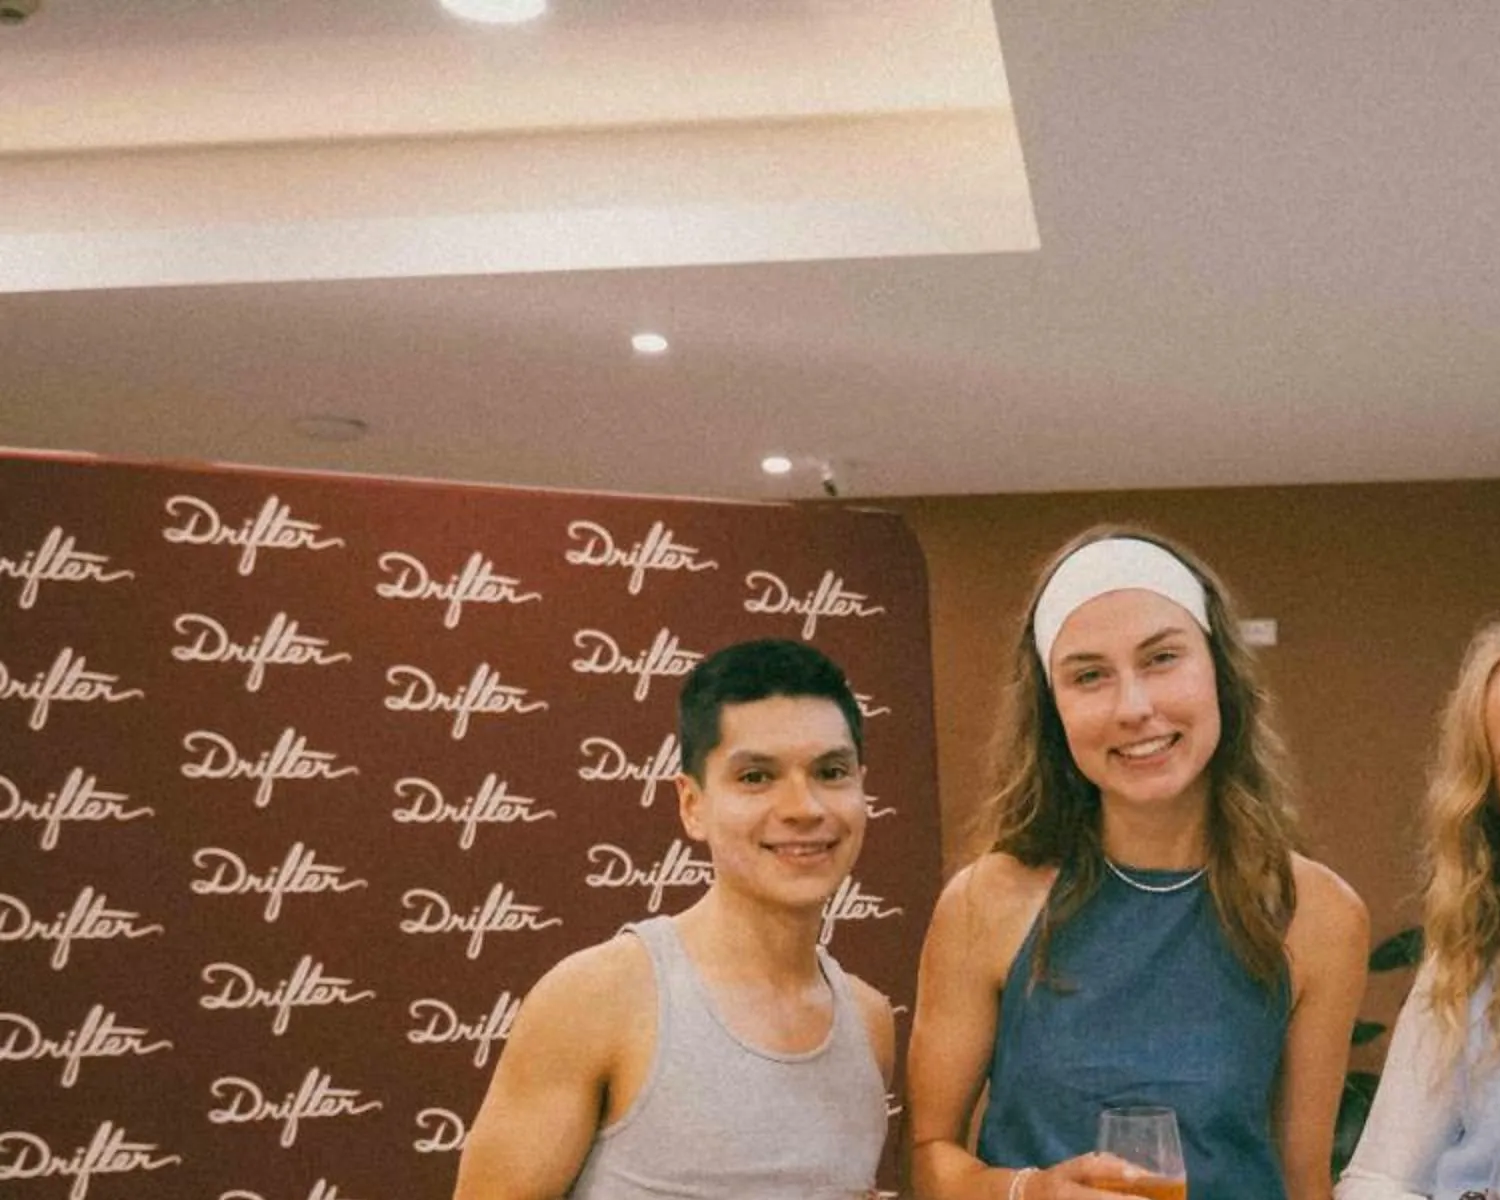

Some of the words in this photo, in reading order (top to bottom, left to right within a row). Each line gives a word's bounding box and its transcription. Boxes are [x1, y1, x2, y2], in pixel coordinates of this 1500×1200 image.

[0, 526, 135, 610] rifter
[164, 495, 345, 576] Drifter
[565, 520, 719, 596] Drifter
[376, 551, 542, 630] Drifter
[743, 570, 885, 641] Drifter
[0, 647, 145, 731] rifter
[171, 612, 352, 693] Drifter
[384, 662, 549, 741] Drifter
[181, 728, 359, 808] Drifter
[578, 733, 682, 807] Drift
[391, 773, 556, 851] Drifter
[191, 842, 368, 923] Drifter
[585, 838, 716, 913] Drifter
[820, 875, 904, 945] ifter
[399, 883, 563, 960] Drifter
[200, 955, 375, 1036] Drifter
[406, 991, 521, 1069] Drift
[0, 1004, 173, 1088] Drifter
[208, 1067, 383, 1148] Drifter
